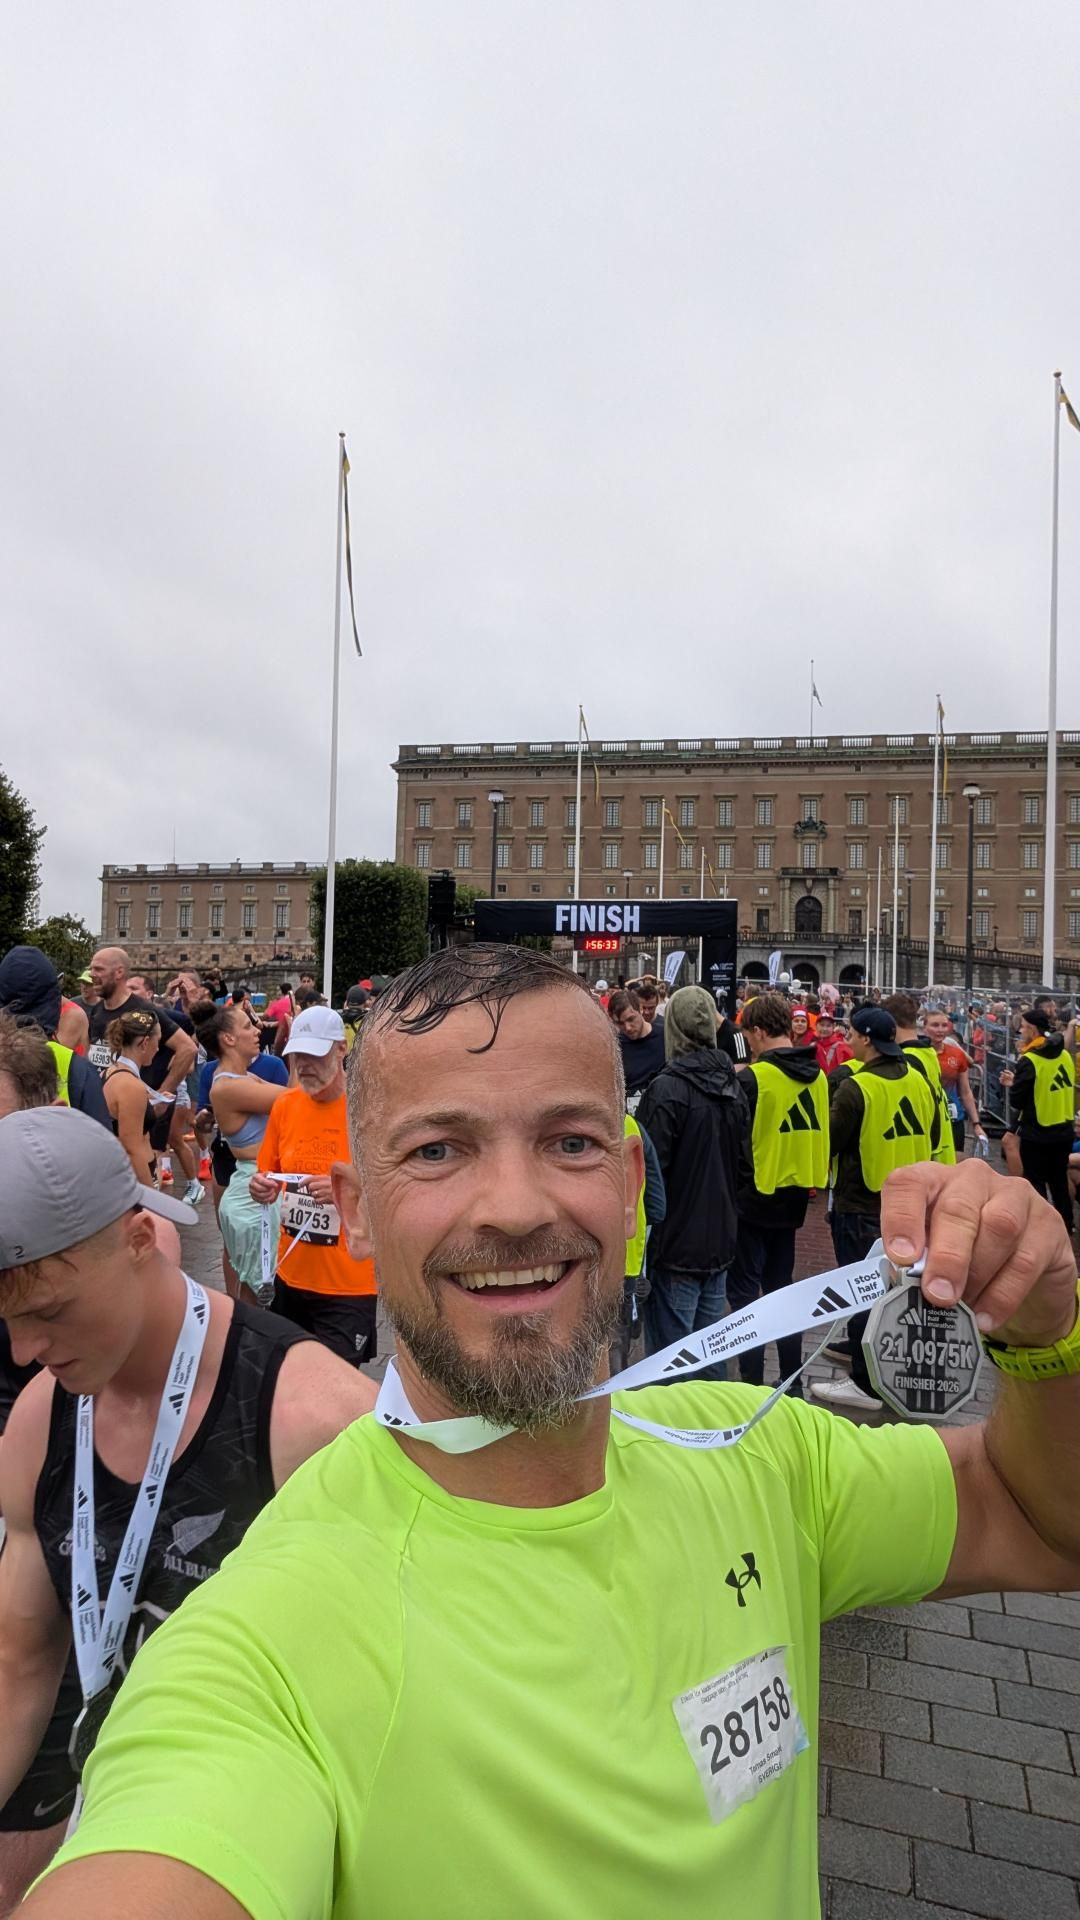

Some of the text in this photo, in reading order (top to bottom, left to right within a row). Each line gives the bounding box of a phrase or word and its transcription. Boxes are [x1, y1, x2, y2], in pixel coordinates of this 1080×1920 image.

[556, 904, 640, 932] FINISH
[585, 940, 618, 950] 1:56:33
[298, 1197, 324, 1210] MAGNUS
[288, 1208, 330, 1231] 10753
[854, 1270, 880, 1285] stock
[858, 1282, 878, 1294] half
[861, 1289, 884, 1303] mara
[706, 1312, 755, 1342] stockholm
[708, 1336, 727, 1350] half
[710, 1330, 758, 1356] marathon
[880, 1336, 973, 1370] 21,0975K
[894, 1376, 960, 1393] FINISHER 2026
[163, 1554, 184, 1574] ALL
[700, 1676, 790, 1775] 28758
